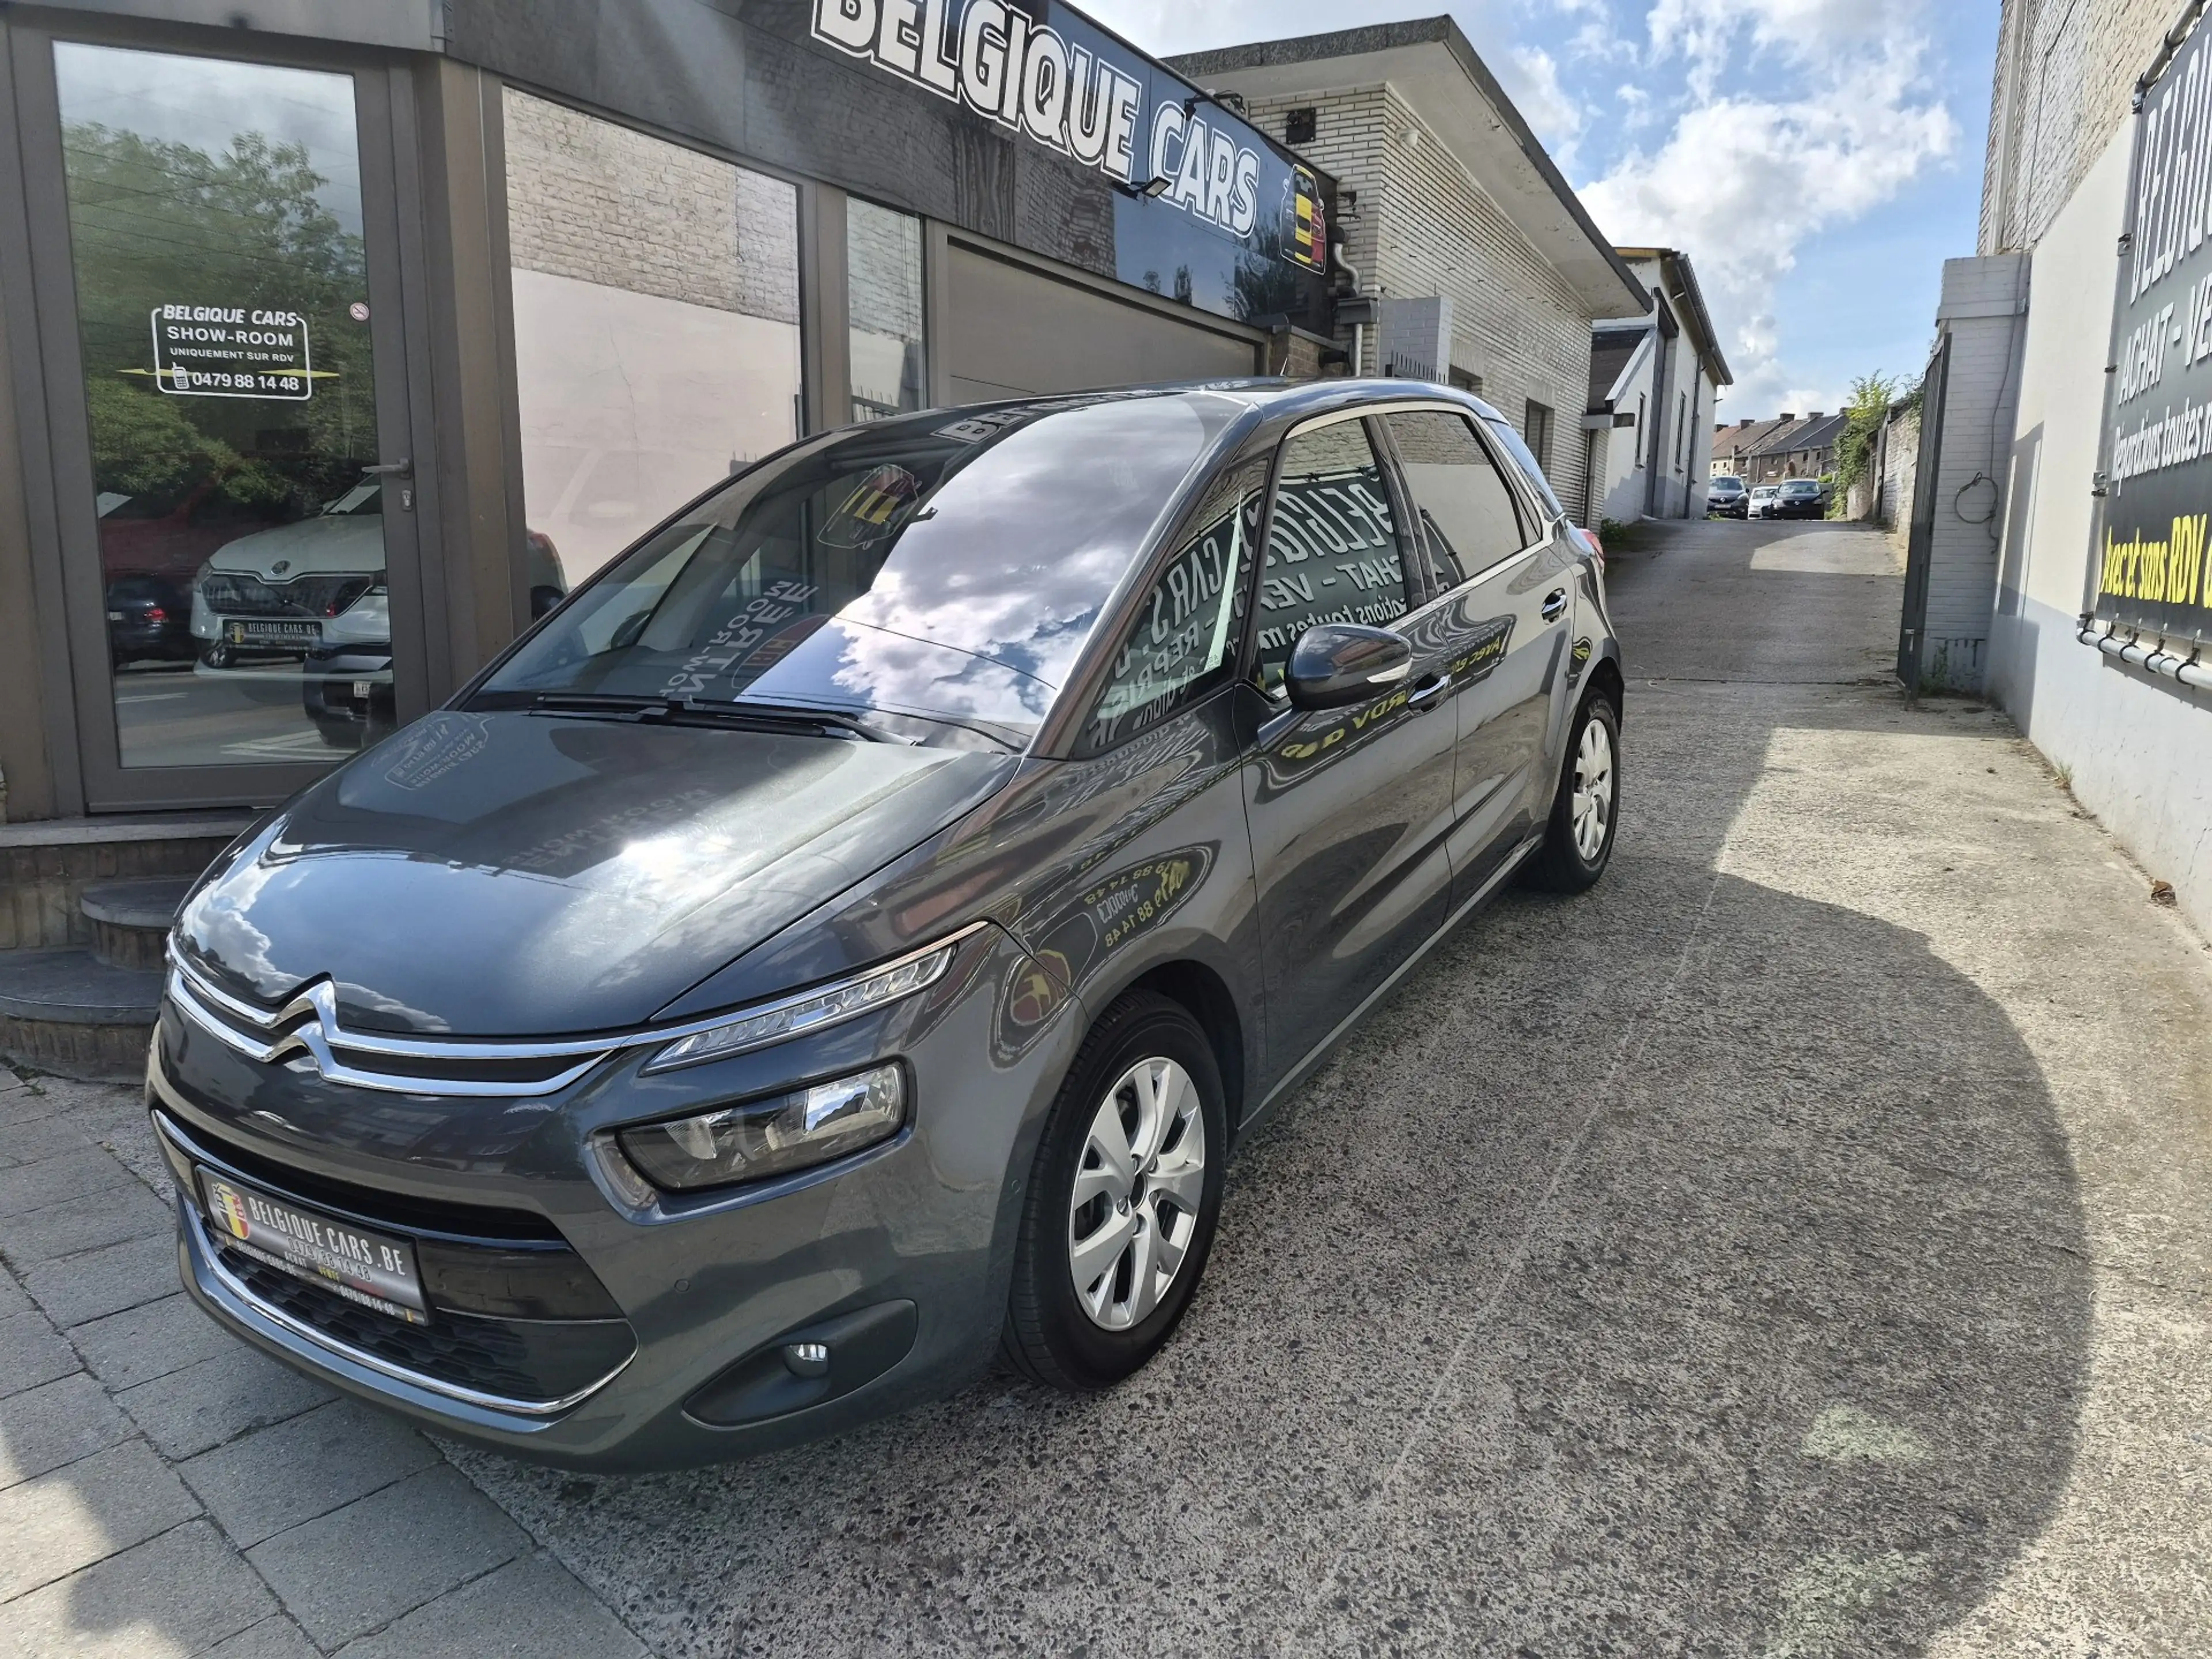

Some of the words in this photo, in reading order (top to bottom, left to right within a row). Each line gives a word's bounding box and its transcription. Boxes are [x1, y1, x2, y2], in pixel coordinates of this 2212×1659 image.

[1150, 101, 1259, 238] CARS
[163, 304, 246, 324] BELGIQUE
[251, 310, 297, 327] CARS
[167, 326, 294, 346] SHOW-ROOM
[170, 348, 244, 360] UNIQUEMENT
[247, 351, 270, 361] SUR
[272, 353, 294, 363] RDV
[2119, 301, 2175, 406] ACHAT
[192, 372, 232, 388] 0479
[234, 373, 255, 389] 88
[258, 375, 276, 389] 14
[279, 376, 300, 391] 48
[2161, 396, 2203, 468] toutes
[2100, 525, 2127, 596] Avec
[2126, 527, 2140, 597] et
[2138, 541, 2168, 602] sans
[2166, 513, 2207, 605] RDV
[248, 1196, 324, 1247] BELGIQUE
[326, 1227, 373, 1265] CARS
[338, 1256, 354, 1276] 14
[357, 1263, 372, 1282] 48
